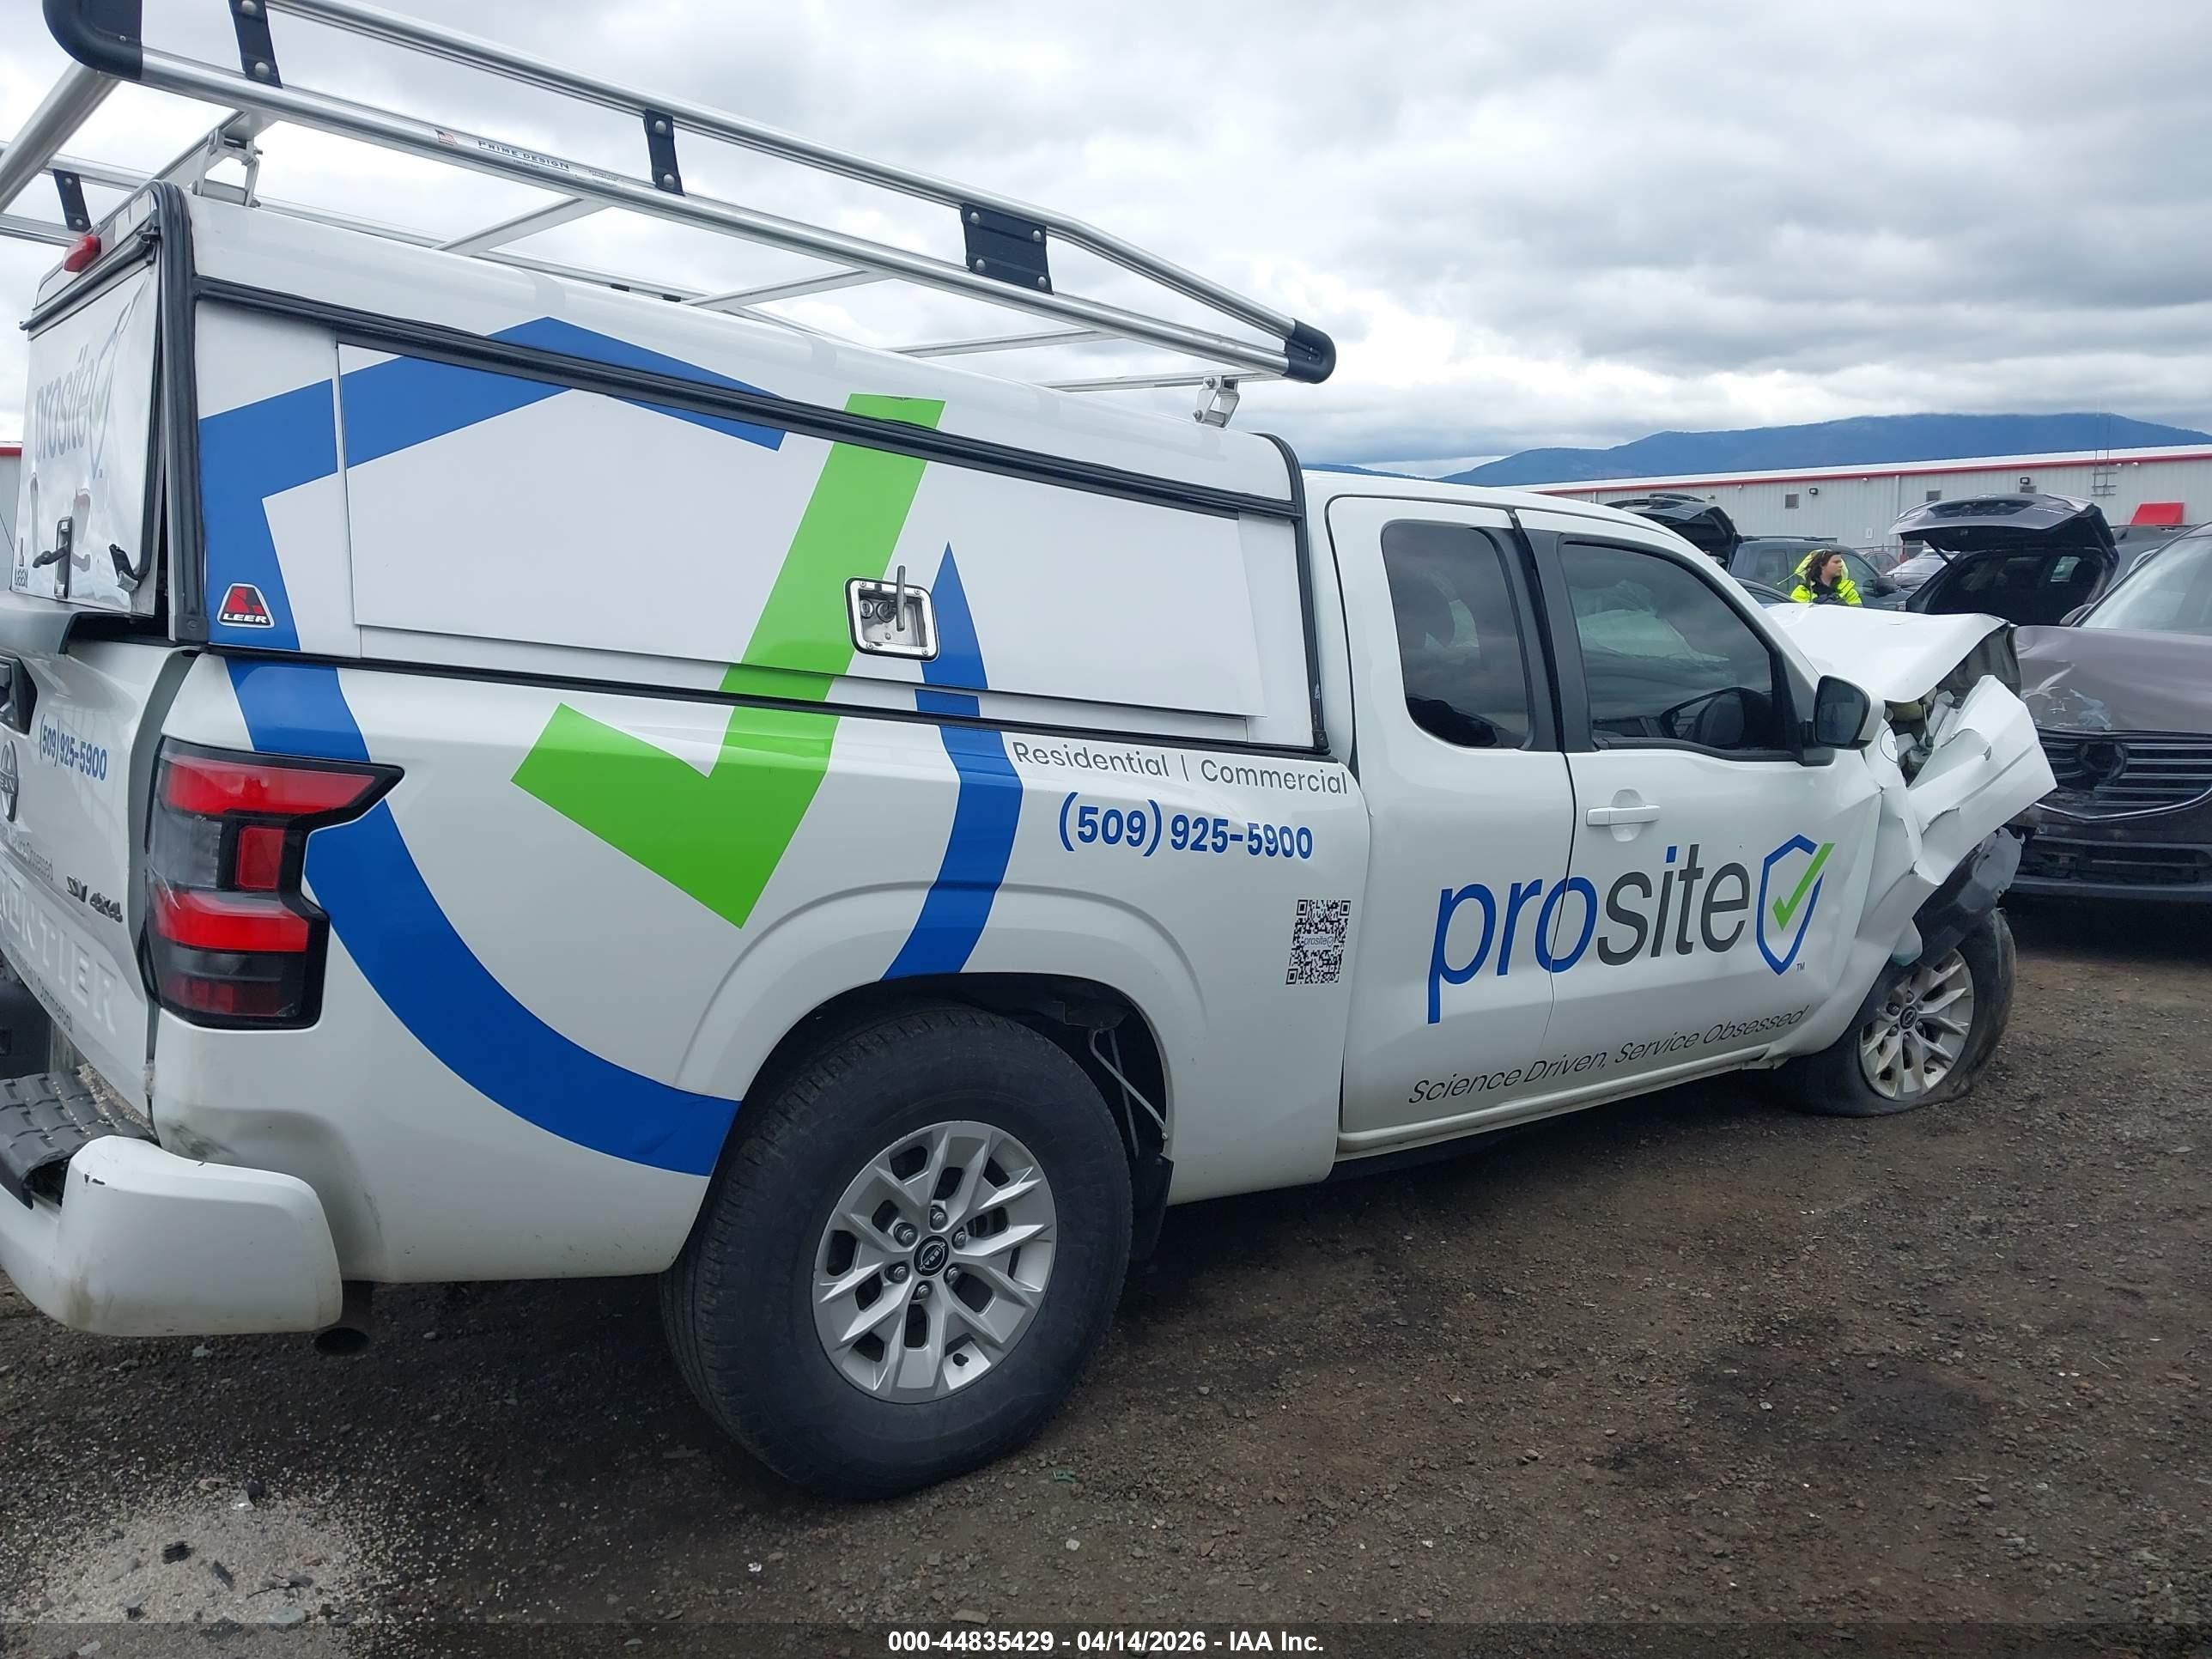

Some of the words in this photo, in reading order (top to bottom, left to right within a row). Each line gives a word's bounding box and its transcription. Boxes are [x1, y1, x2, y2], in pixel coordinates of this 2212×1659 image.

[478, 140, 518, 155] PRIME
[523, 153, 569, 170] DESIGN
[34, 343, 94, 463] prosite
[222, 612, 268, 624] LEER
[39, 713, 60, 768] (509)
[60, 732, 107, 781] 925-5900
[1013, 741, 1170, 778] Residential
[1200, 759, 1347, 795] Commercial
[1060, 792, 1163, 857] (509)
[1170, 814, 1313, 860] 925-5900
[1427, 843, 1750, 1024] prosite
[1408, 1068, 1522, 1103] Science
[1614, 1031, 1699, 1063] Service
[1703, 1004, 1809, 1044] Obsessed
